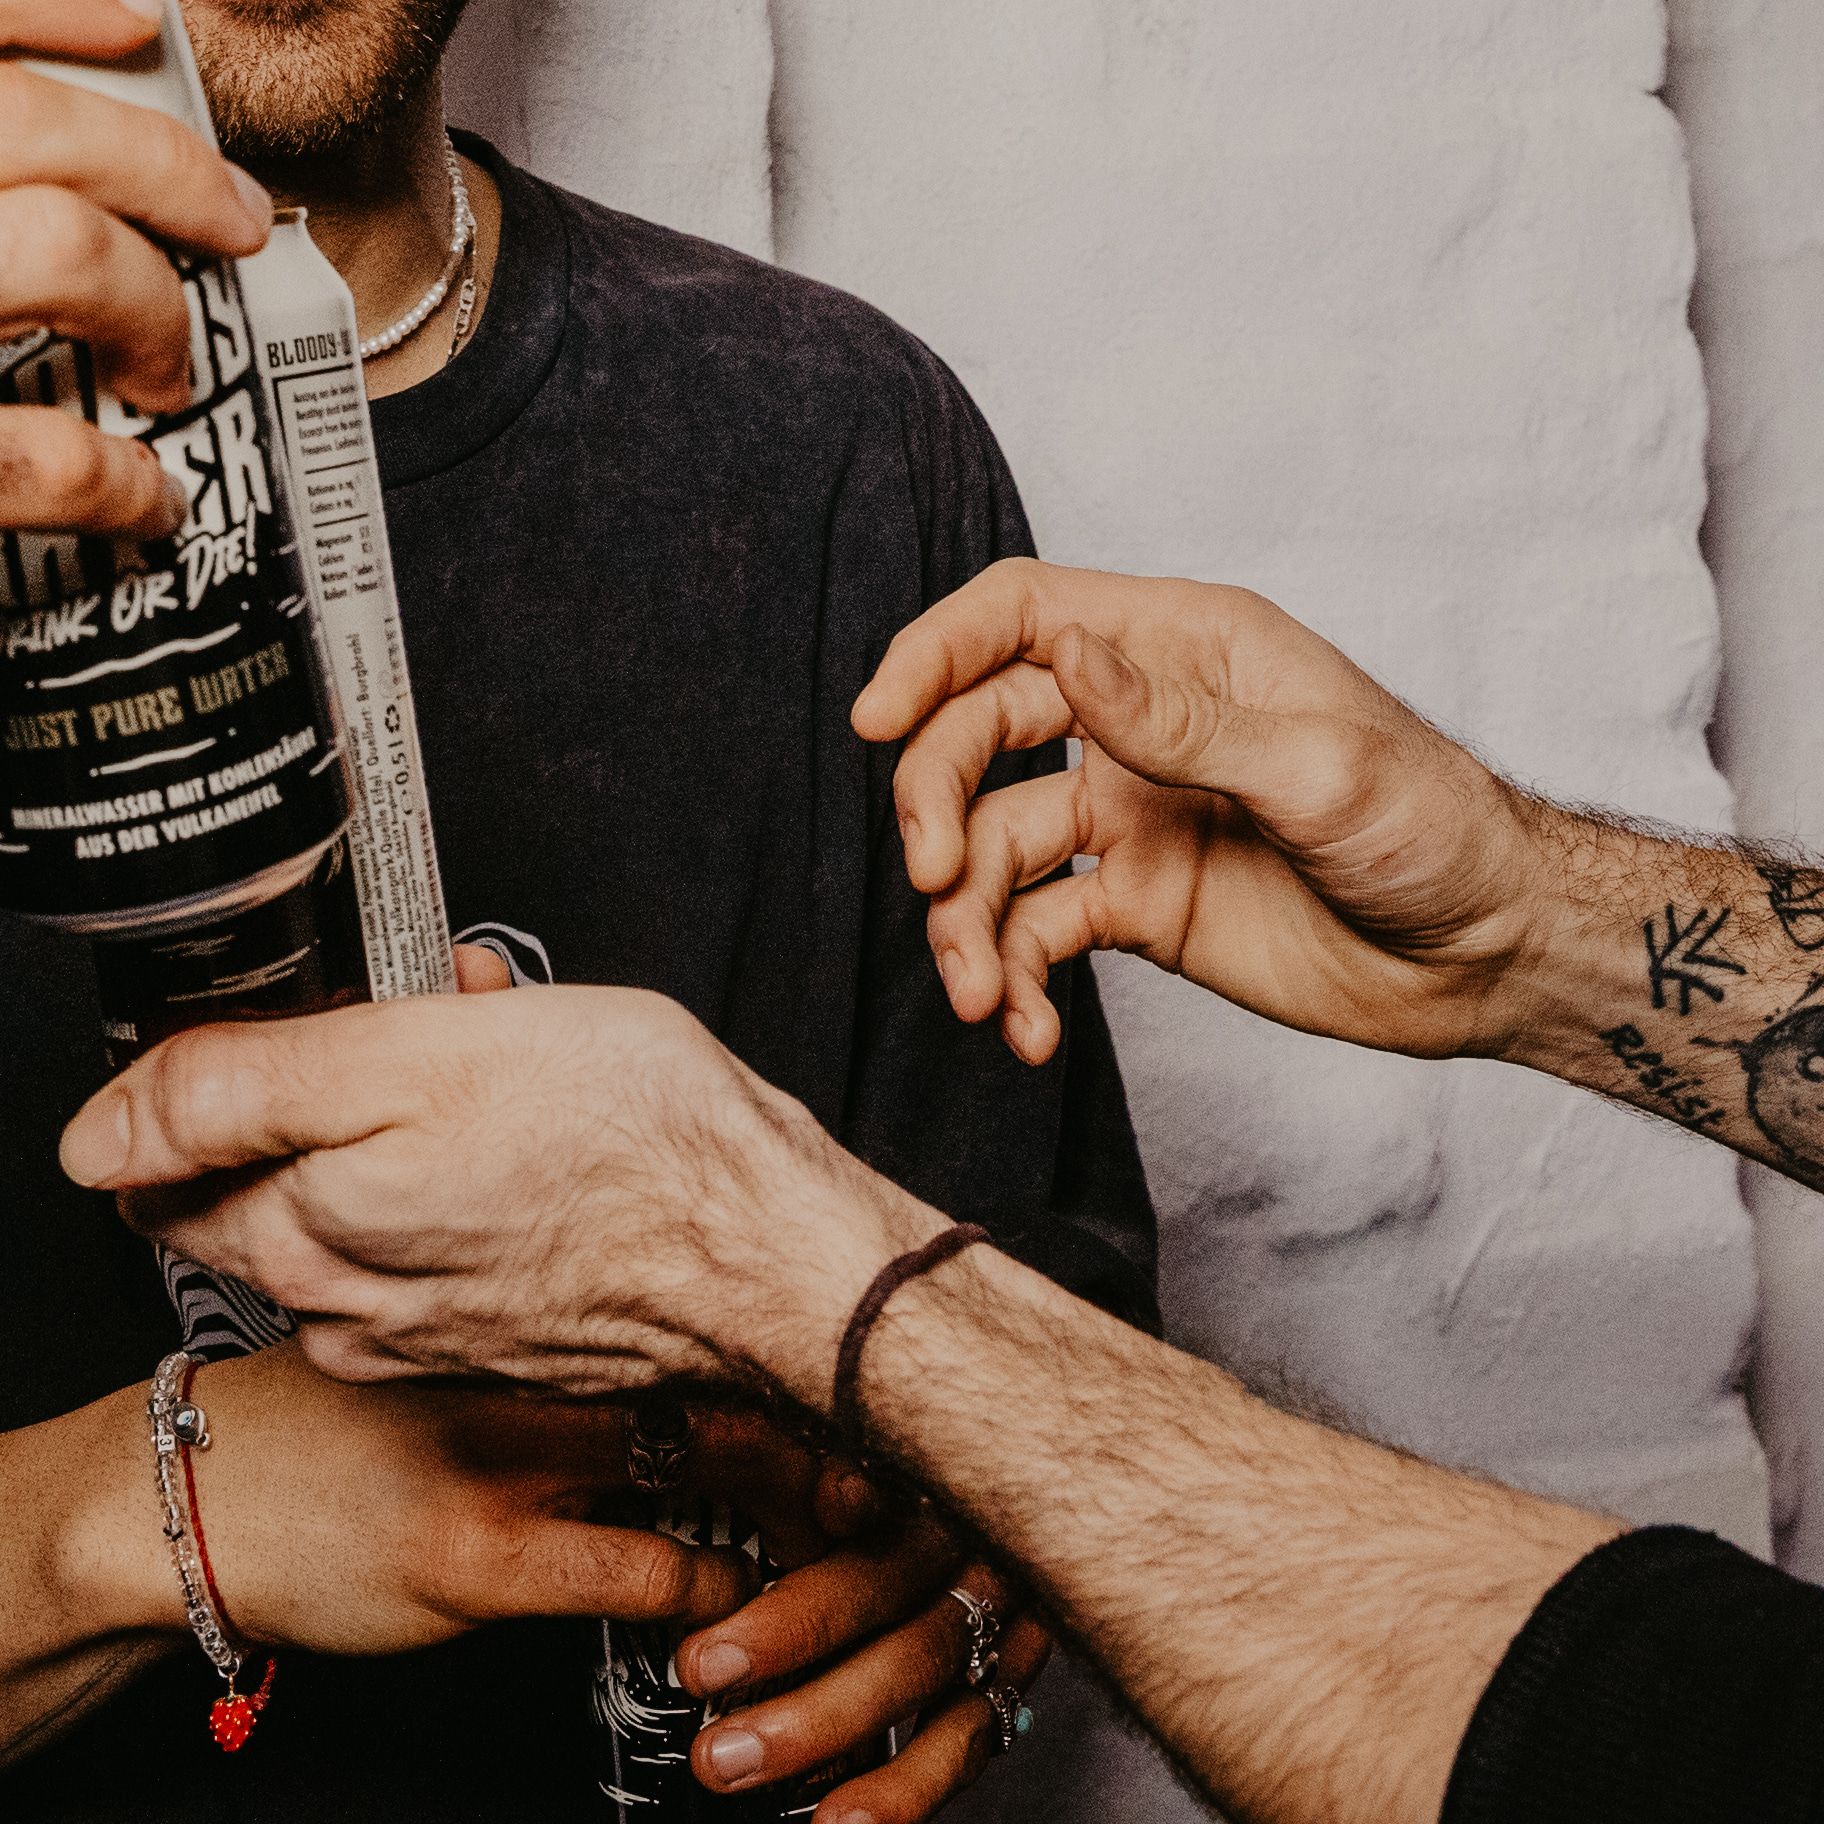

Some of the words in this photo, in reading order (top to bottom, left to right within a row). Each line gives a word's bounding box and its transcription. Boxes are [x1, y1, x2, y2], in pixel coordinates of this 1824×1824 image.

[110, 570, 180, 634] OR
[176, 500, 257, 611] DIE!
[4, 709, 80, 751] JUST
[89, 685, 185, 742] PURE
[189, 640, 289, 715] WATER
[345, 632, 372, 702] Burgbrohl
[11, 789, 165, 830] MINERALWASSER
[166, 777, 206, 811] MIT
[76, 832, 117, 859] AUS
[117, 824, 159, 855] DER
[159, 782, 283, 843] VULKANEIFEL
